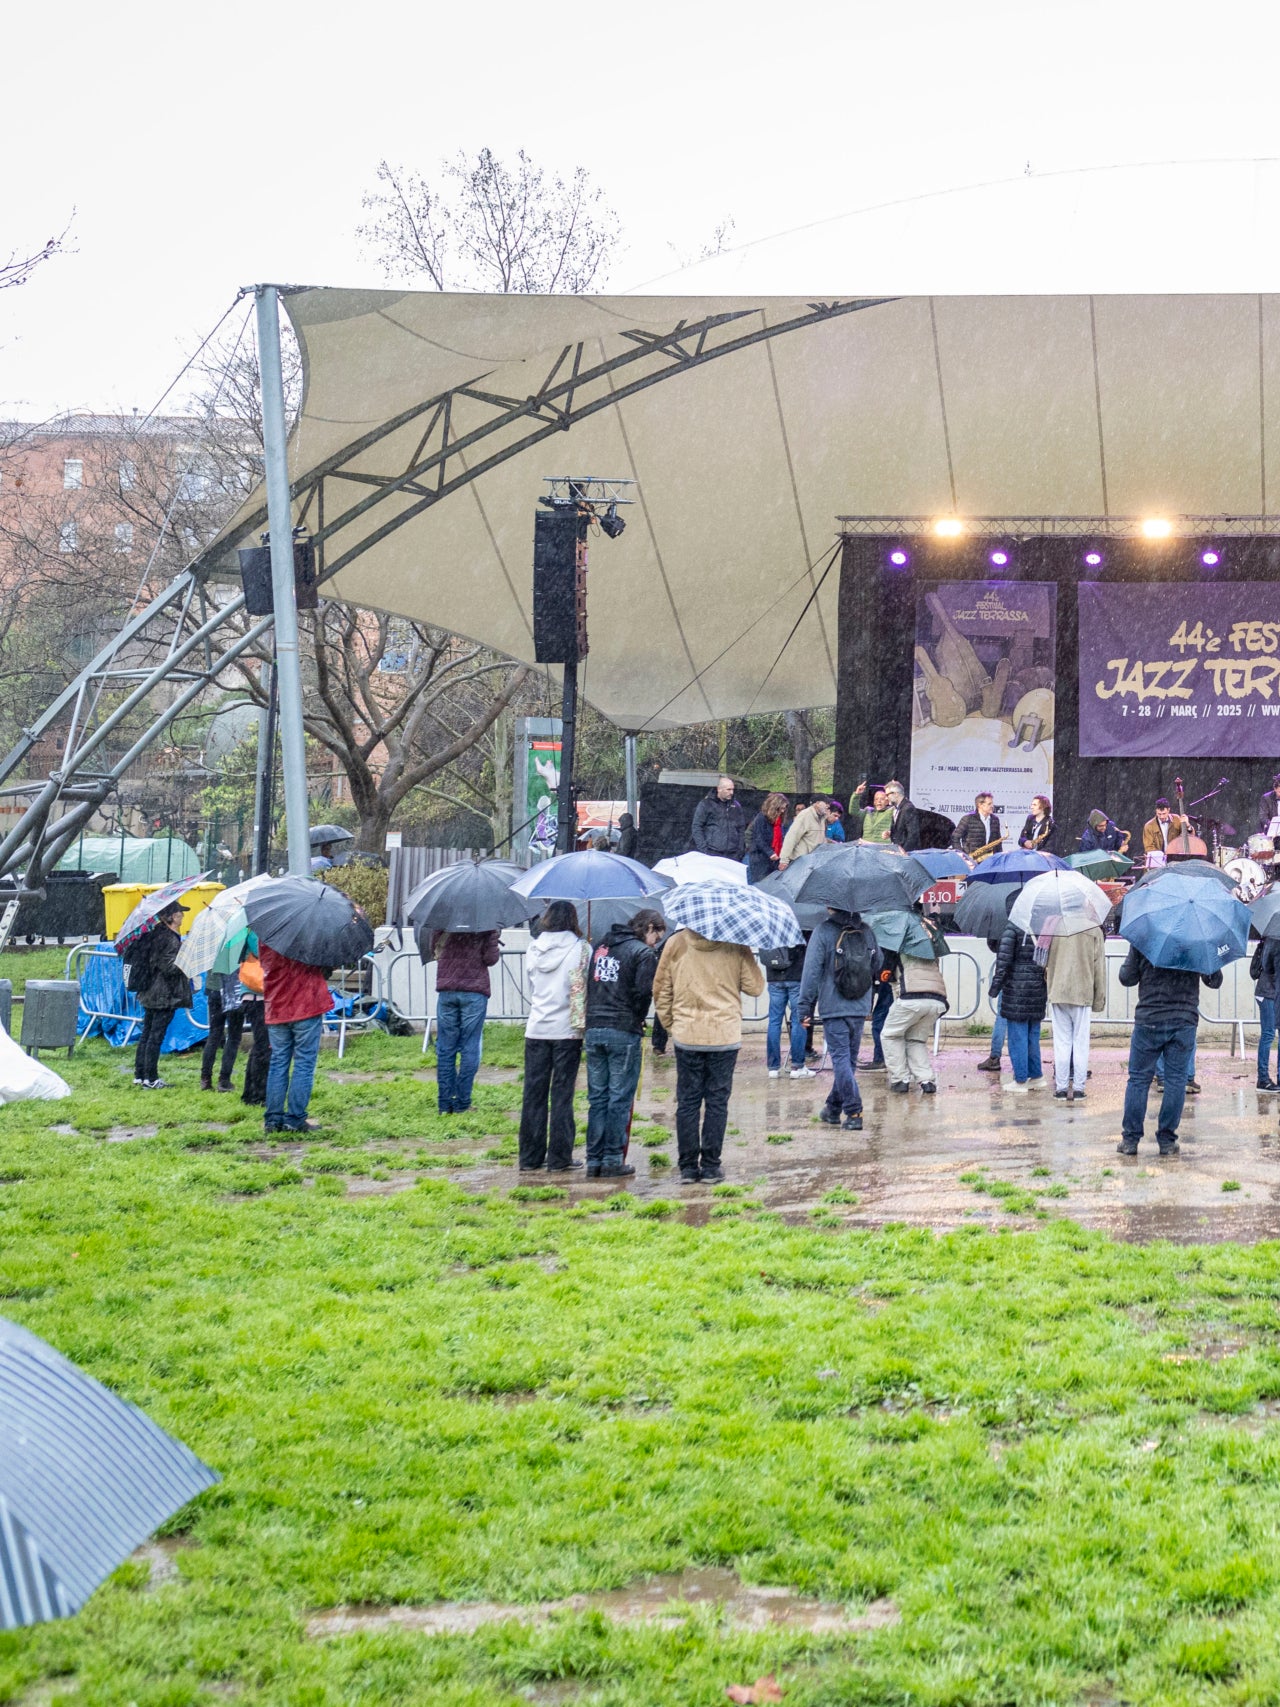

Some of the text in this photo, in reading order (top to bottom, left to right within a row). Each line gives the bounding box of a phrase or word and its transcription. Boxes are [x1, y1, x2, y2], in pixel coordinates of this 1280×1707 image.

[952, 610, 1029, 621] JAZZ TERRASSA
[1169, 620, 1221, 653] 44è
[1095, 657, 1198, 702] JAZZ
[1122, 705, 1128, 717] 7
[1138, 705, 1151, 717] 28
[1171, 705, 1197, 719] MARÇ
[1217, 704, 1242, 717] 2025
[928, 892, 952, 903] BJO
